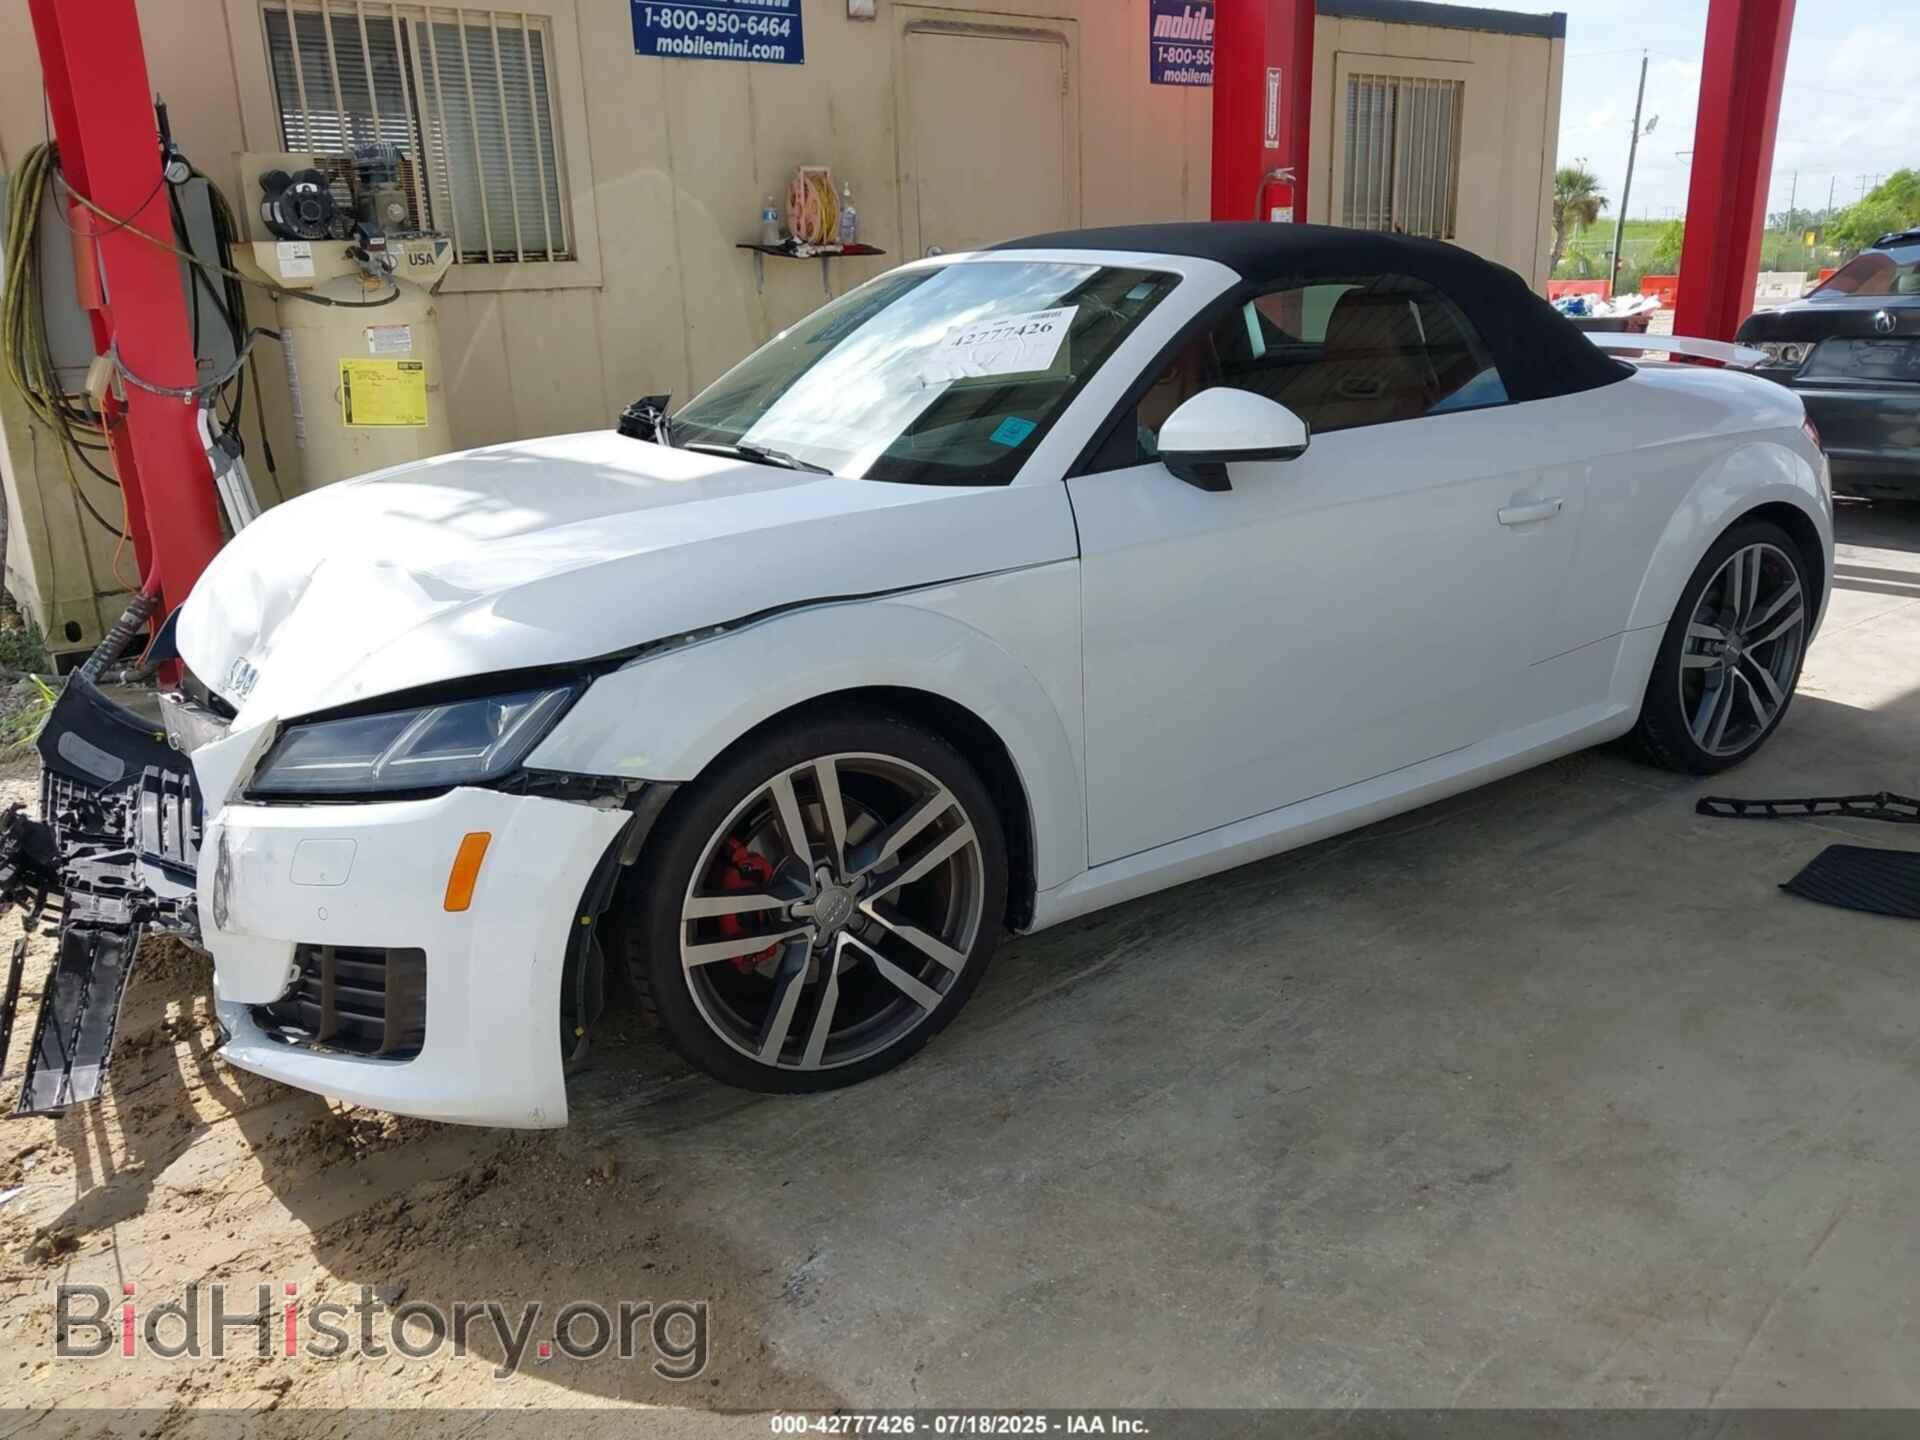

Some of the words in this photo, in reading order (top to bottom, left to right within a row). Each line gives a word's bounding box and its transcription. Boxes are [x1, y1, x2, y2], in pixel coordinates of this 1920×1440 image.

[645, 7, 791, 38] 1-800-950-6464
[656, 34, 785, 60] mobilemini.com
[408, 252, 435, 266] USA
[951, 322, 1053, 346] 42777426
